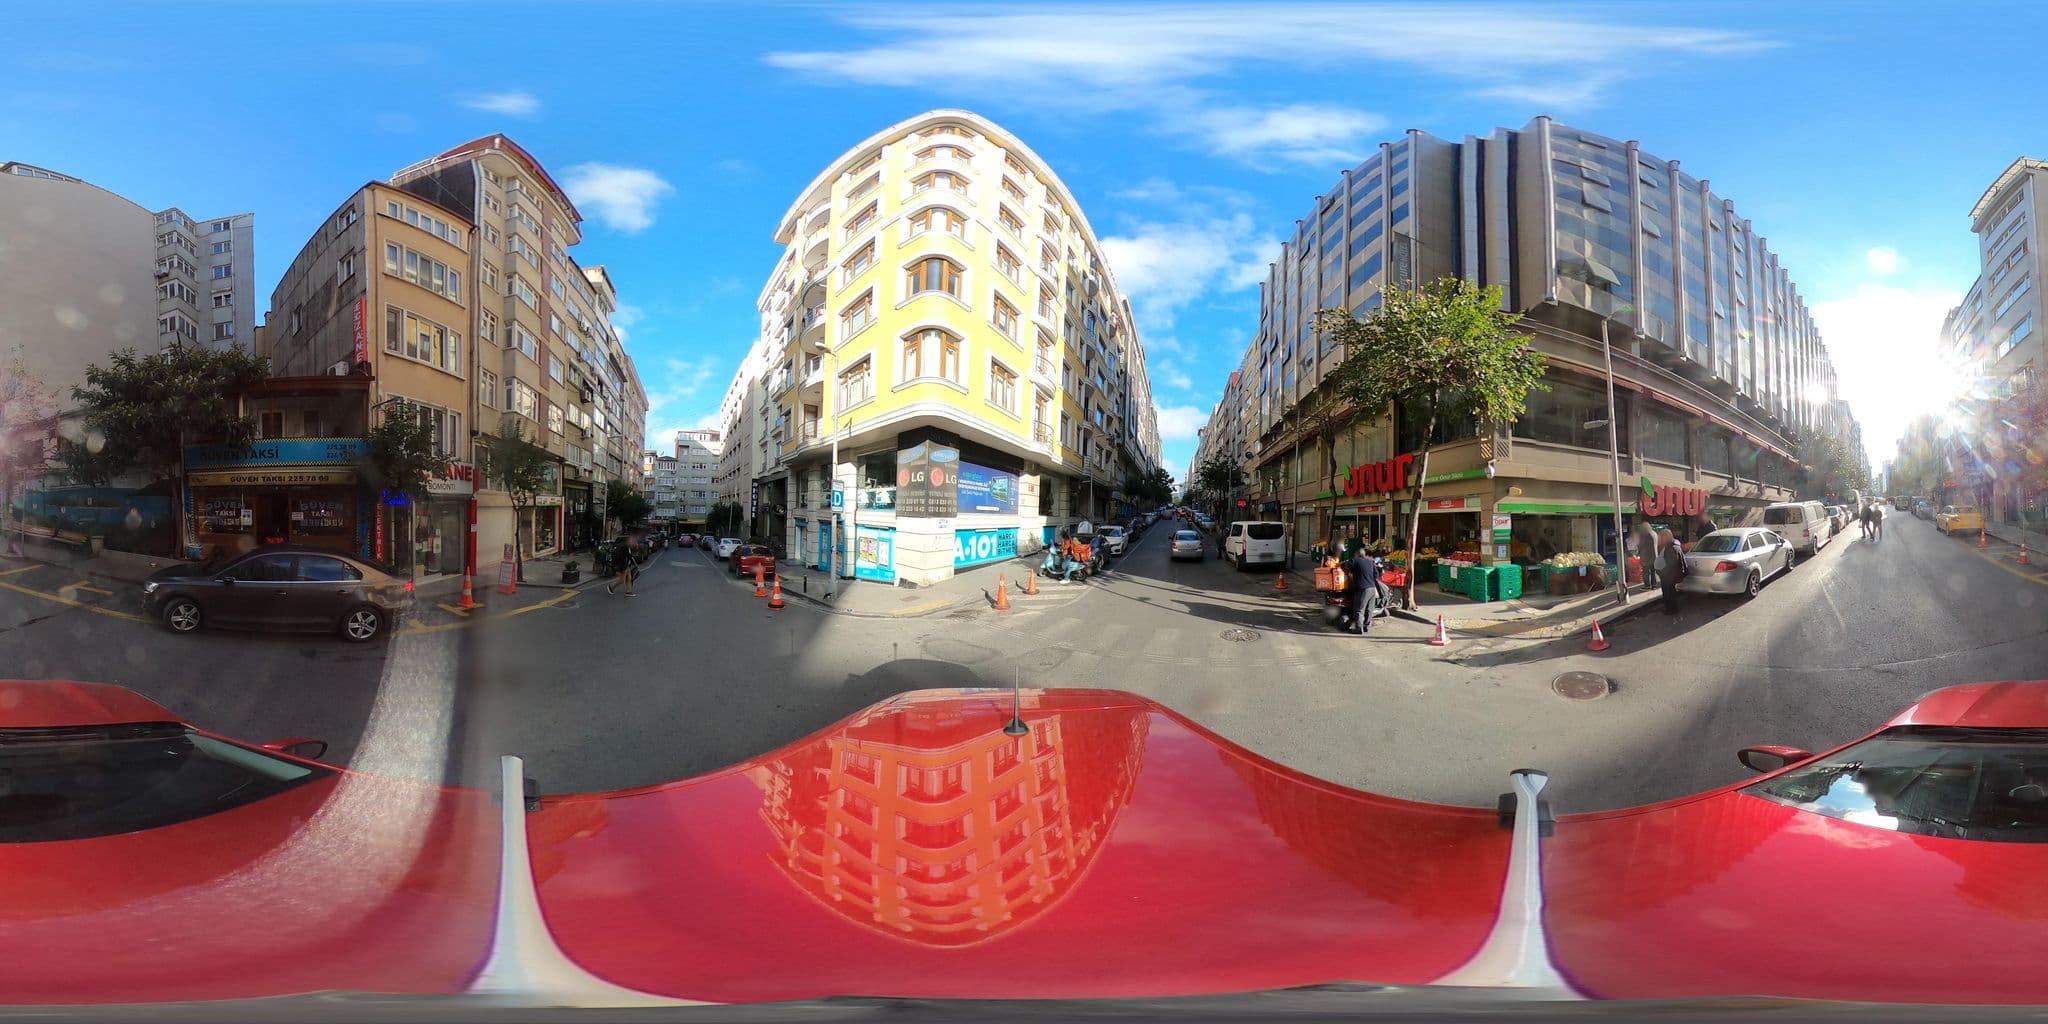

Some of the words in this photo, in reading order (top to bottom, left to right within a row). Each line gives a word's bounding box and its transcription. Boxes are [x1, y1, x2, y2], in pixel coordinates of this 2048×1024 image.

[354, 302, 362, 362] ECZANE
[244, 446, 279, 460] TAKSİ
[288, 474, 304, 482] 225
[911, 472, 925, 482] LG
[945, 474, 957, 485] LG
